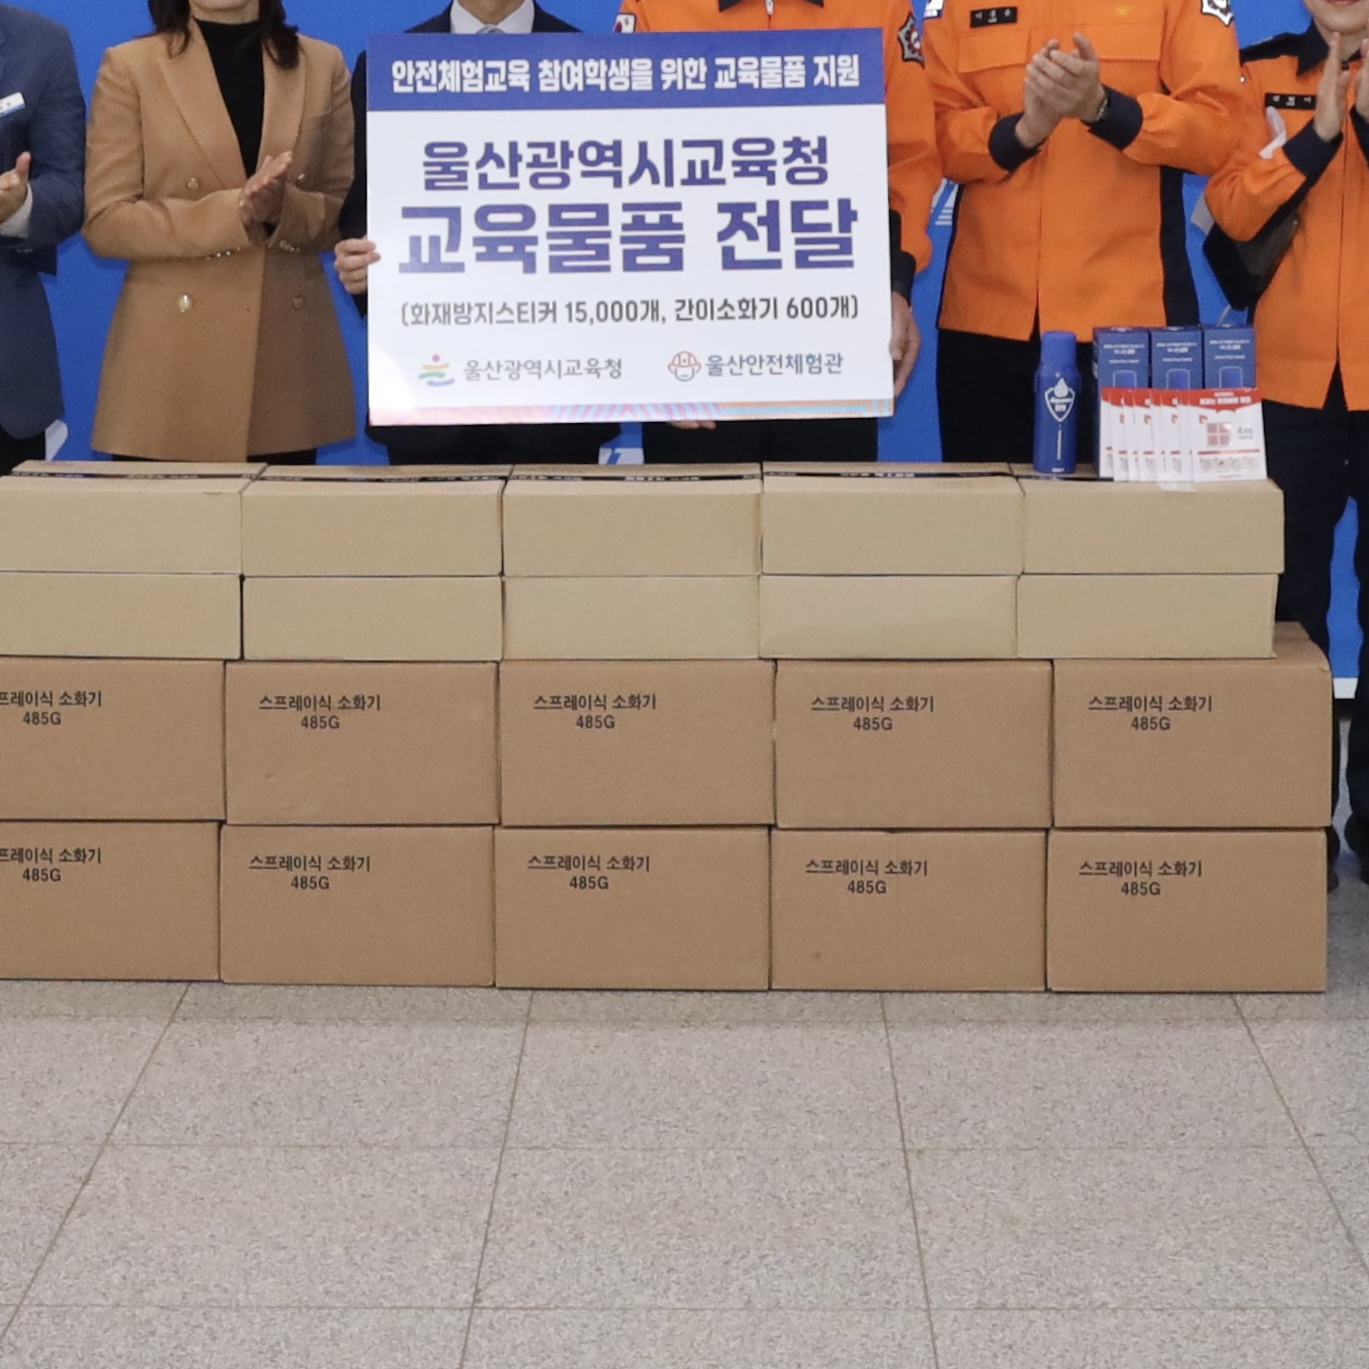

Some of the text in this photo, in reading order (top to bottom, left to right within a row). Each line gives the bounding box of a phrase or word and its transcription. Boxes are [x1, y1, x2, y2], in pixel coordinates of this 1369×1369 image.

[391, 54, 860, 93] 안전체험교육 참여학생을 위한 교육물품 지원
[423, 136, 828, 191] 울산광역시교육청
[399, 200, 685, 274] 교육물품
[716, 198, 858, 271] 전달
[401, 294, 859, 327] (화재방지스티커 15,000개, 간이소화기 600개)
[464, 357, 623, 381] 울산광역시교육청
[706, 353, 844, 377] 울산안전체험관
[59, 690, 102, 709] 소화기
[258, 694, 381, 713] 스프레이식 소화기
[534, 693, 657, 713] 스프레이식 소화기
[811, 695, 934, 715] 스프레이식 소화기
[1088, 695, 1212, 715] 스프레이식 소화기
[22, 712, 61, 726] 485G
[300, 715, 339, 730] 485G
[575, 714, 615, 730] 485G
[853, 717, 893, 732] 485G
[1131, 717, 1170, 732] 485G
[59, 847, 102, 866] 소화기
[249, 855, 371, 874] 스프레이식 소화기
[527, 854, 650, 874] 스프레이식 소화기
[22, 868, 61, 883] 485G
[805, 859, 928, 879] 스프레이식 소화기
[1079, 860, 1202, 880] 스프레이식 소화기
[291, 875, 330, 891] 485G
[569, 875, 609, 891] 485G
[847, 880, 887, 896] 485G
[1121, 881, 1161, 897] 485G
